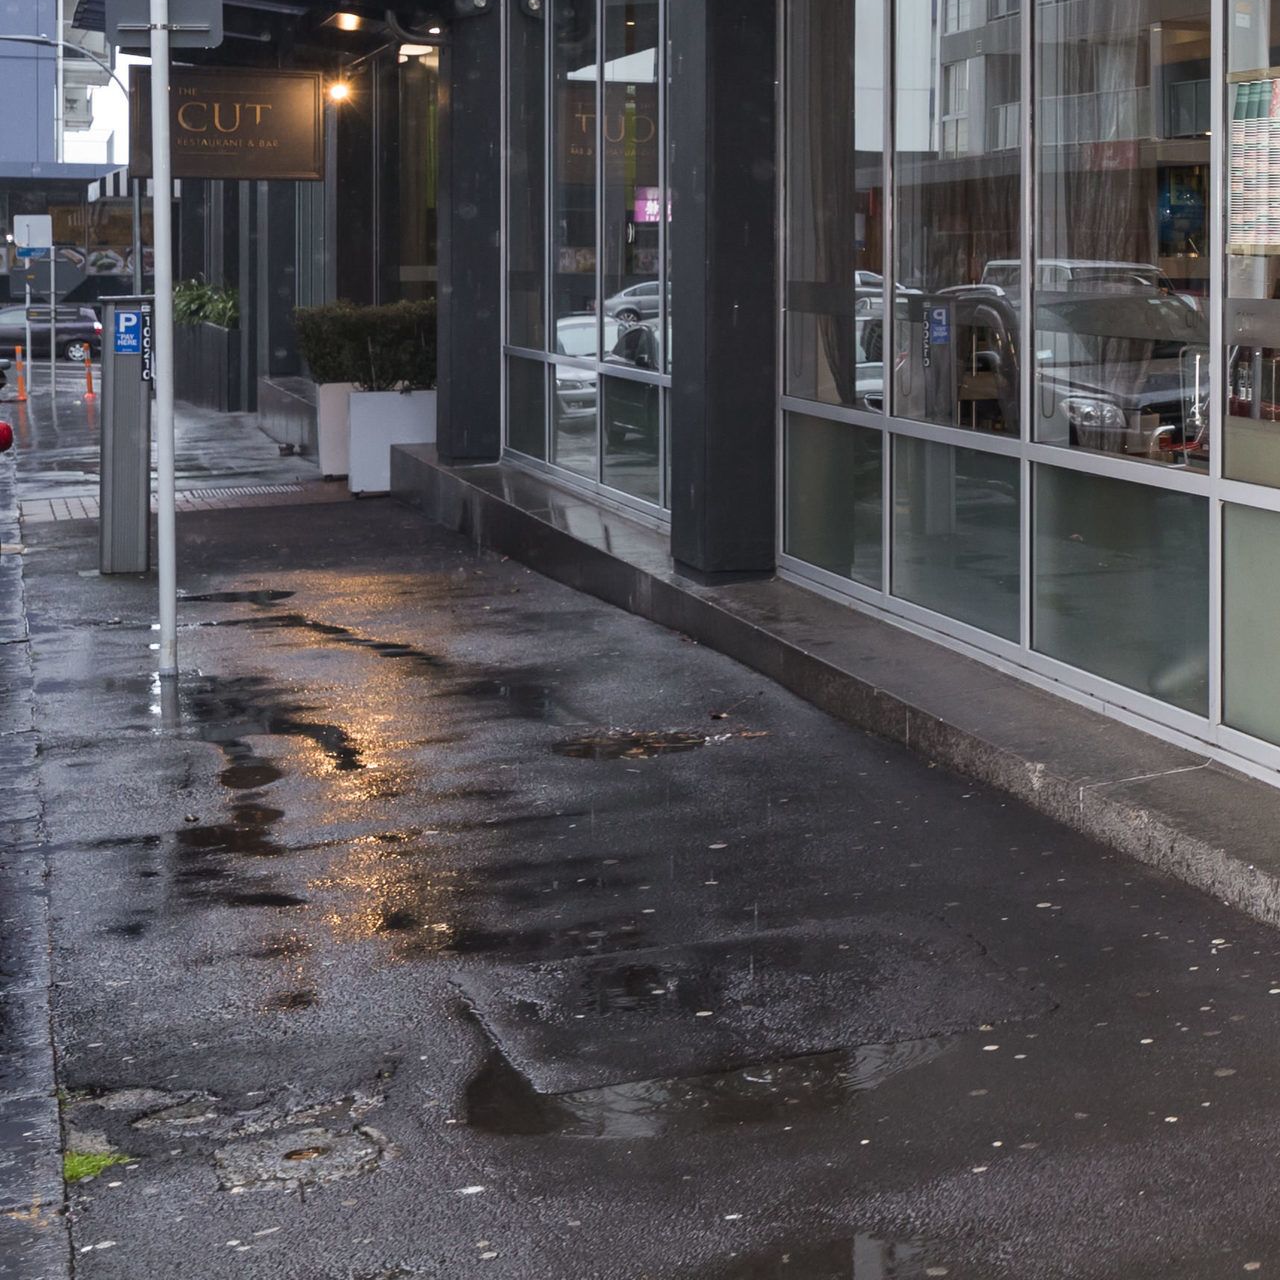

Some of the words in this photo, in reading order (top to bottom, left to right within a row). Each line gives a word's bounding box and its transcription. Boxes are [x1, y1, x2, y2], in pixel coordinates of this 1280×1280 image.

[178, 87, 197, 96] THE
[177, 101, 272, 133] CUT
[177, 139, 242, 148] RESTAURANT
[247, 139, 254, 147] &
[259, 139, 279, 148] BAR
[119, 313, 137, 332] P
